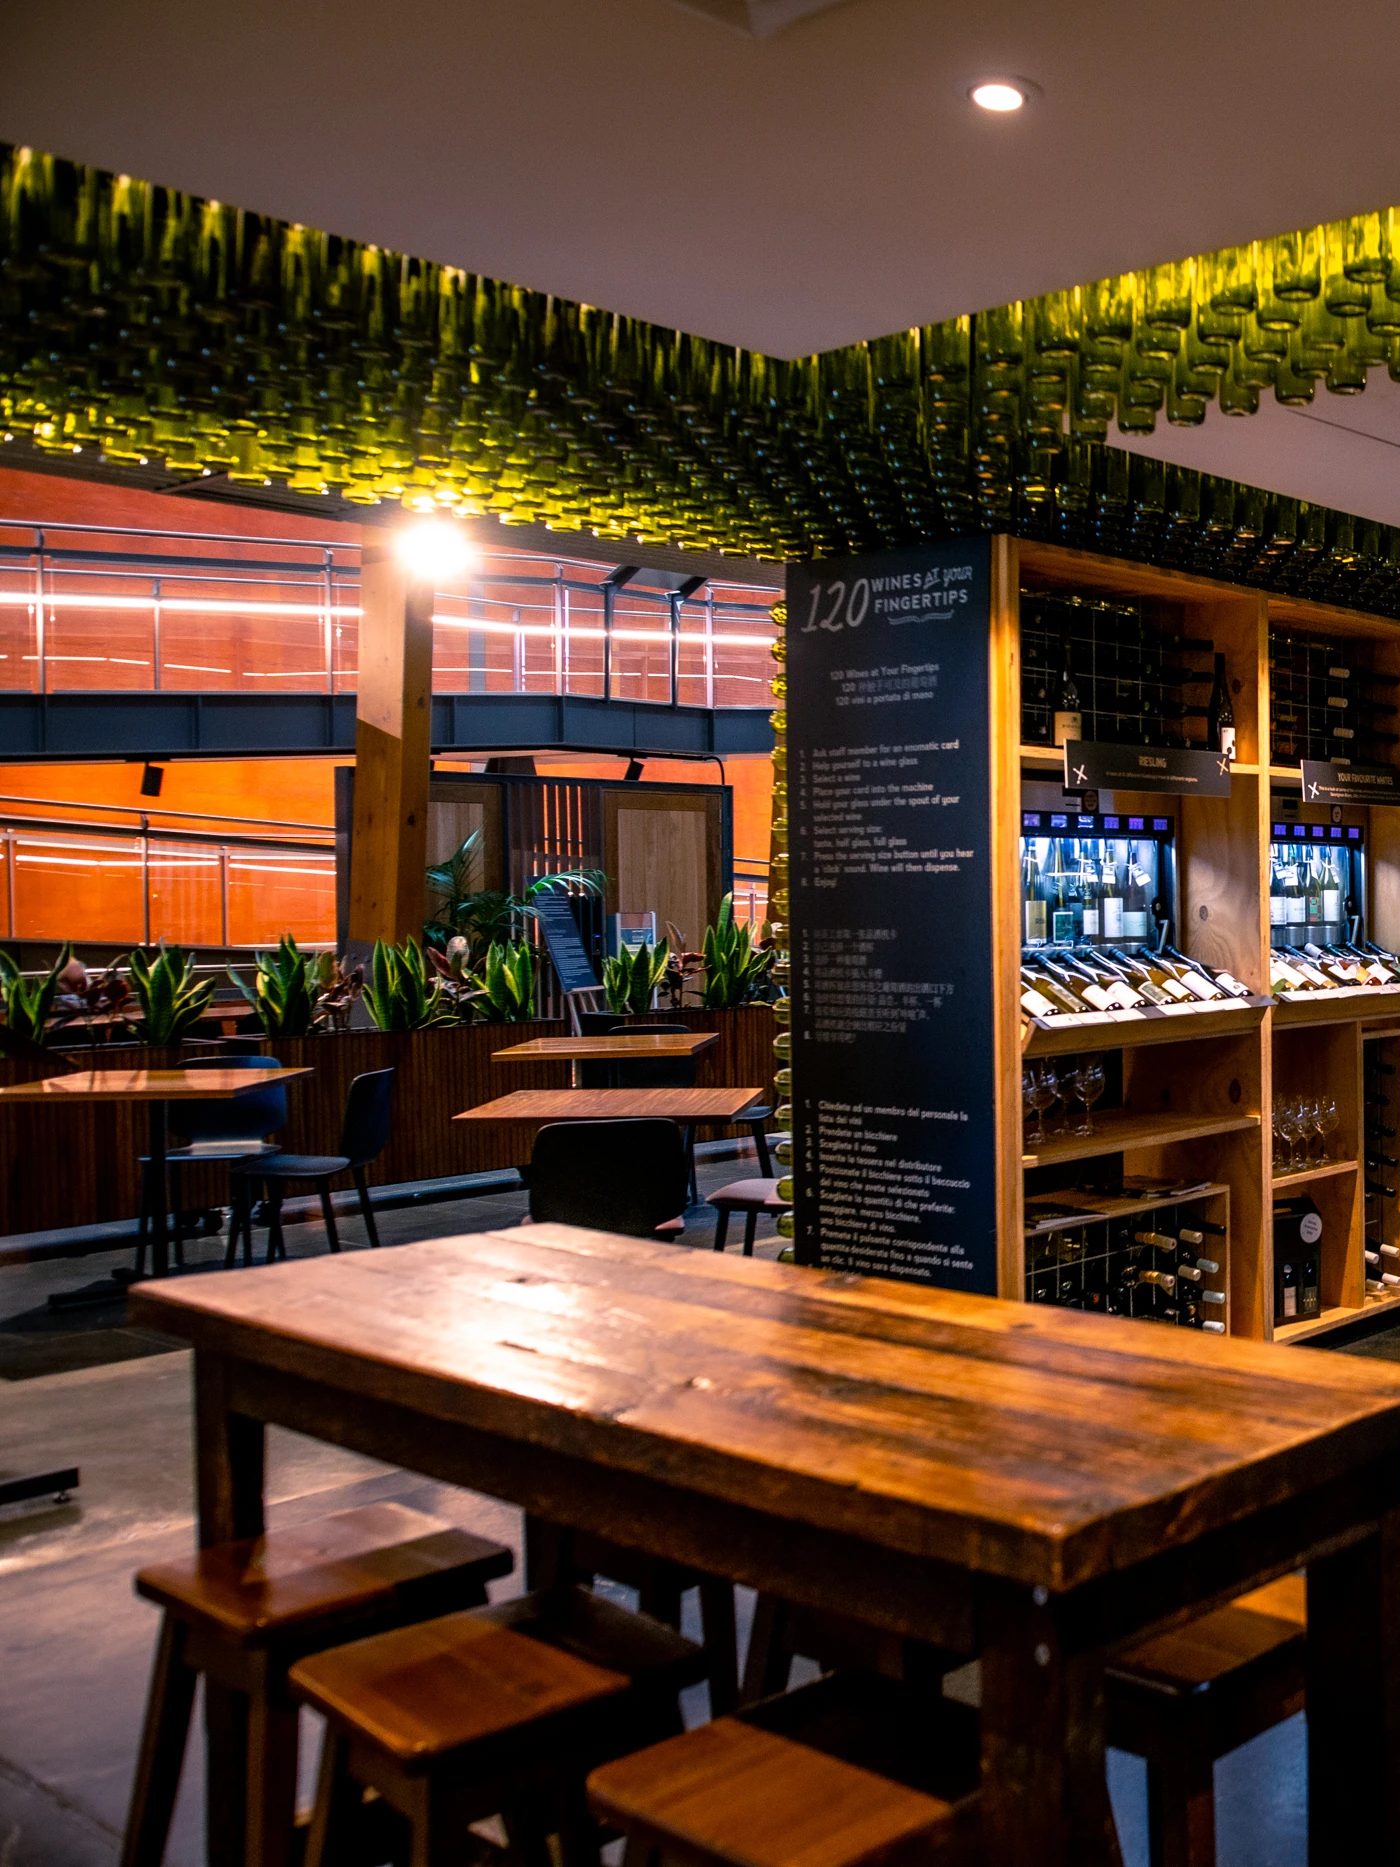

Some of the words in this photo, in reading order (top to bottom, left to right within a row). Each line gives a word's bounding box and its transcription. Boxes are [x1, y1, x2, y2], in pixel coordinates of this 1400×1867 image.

[801, 578, 869, 634] 120
[871, 573, 922, 592] WINES
[874, 589, 969, 614] FINGERTIPS
[940, 739, 960, 750] card
[1138, 755, 1167, 769] RIESLING
[901, 782, 934, 792] machine
[931, 794, 941, 804] of
[941, 796, 960, 806] your
[920, 848, 938, 858] until
[939, 851, 955, 861] you
[955, 848, 974, 858] hear
[905, 862, 923, 872] then
[924, 862, 961, 874] dispense.
